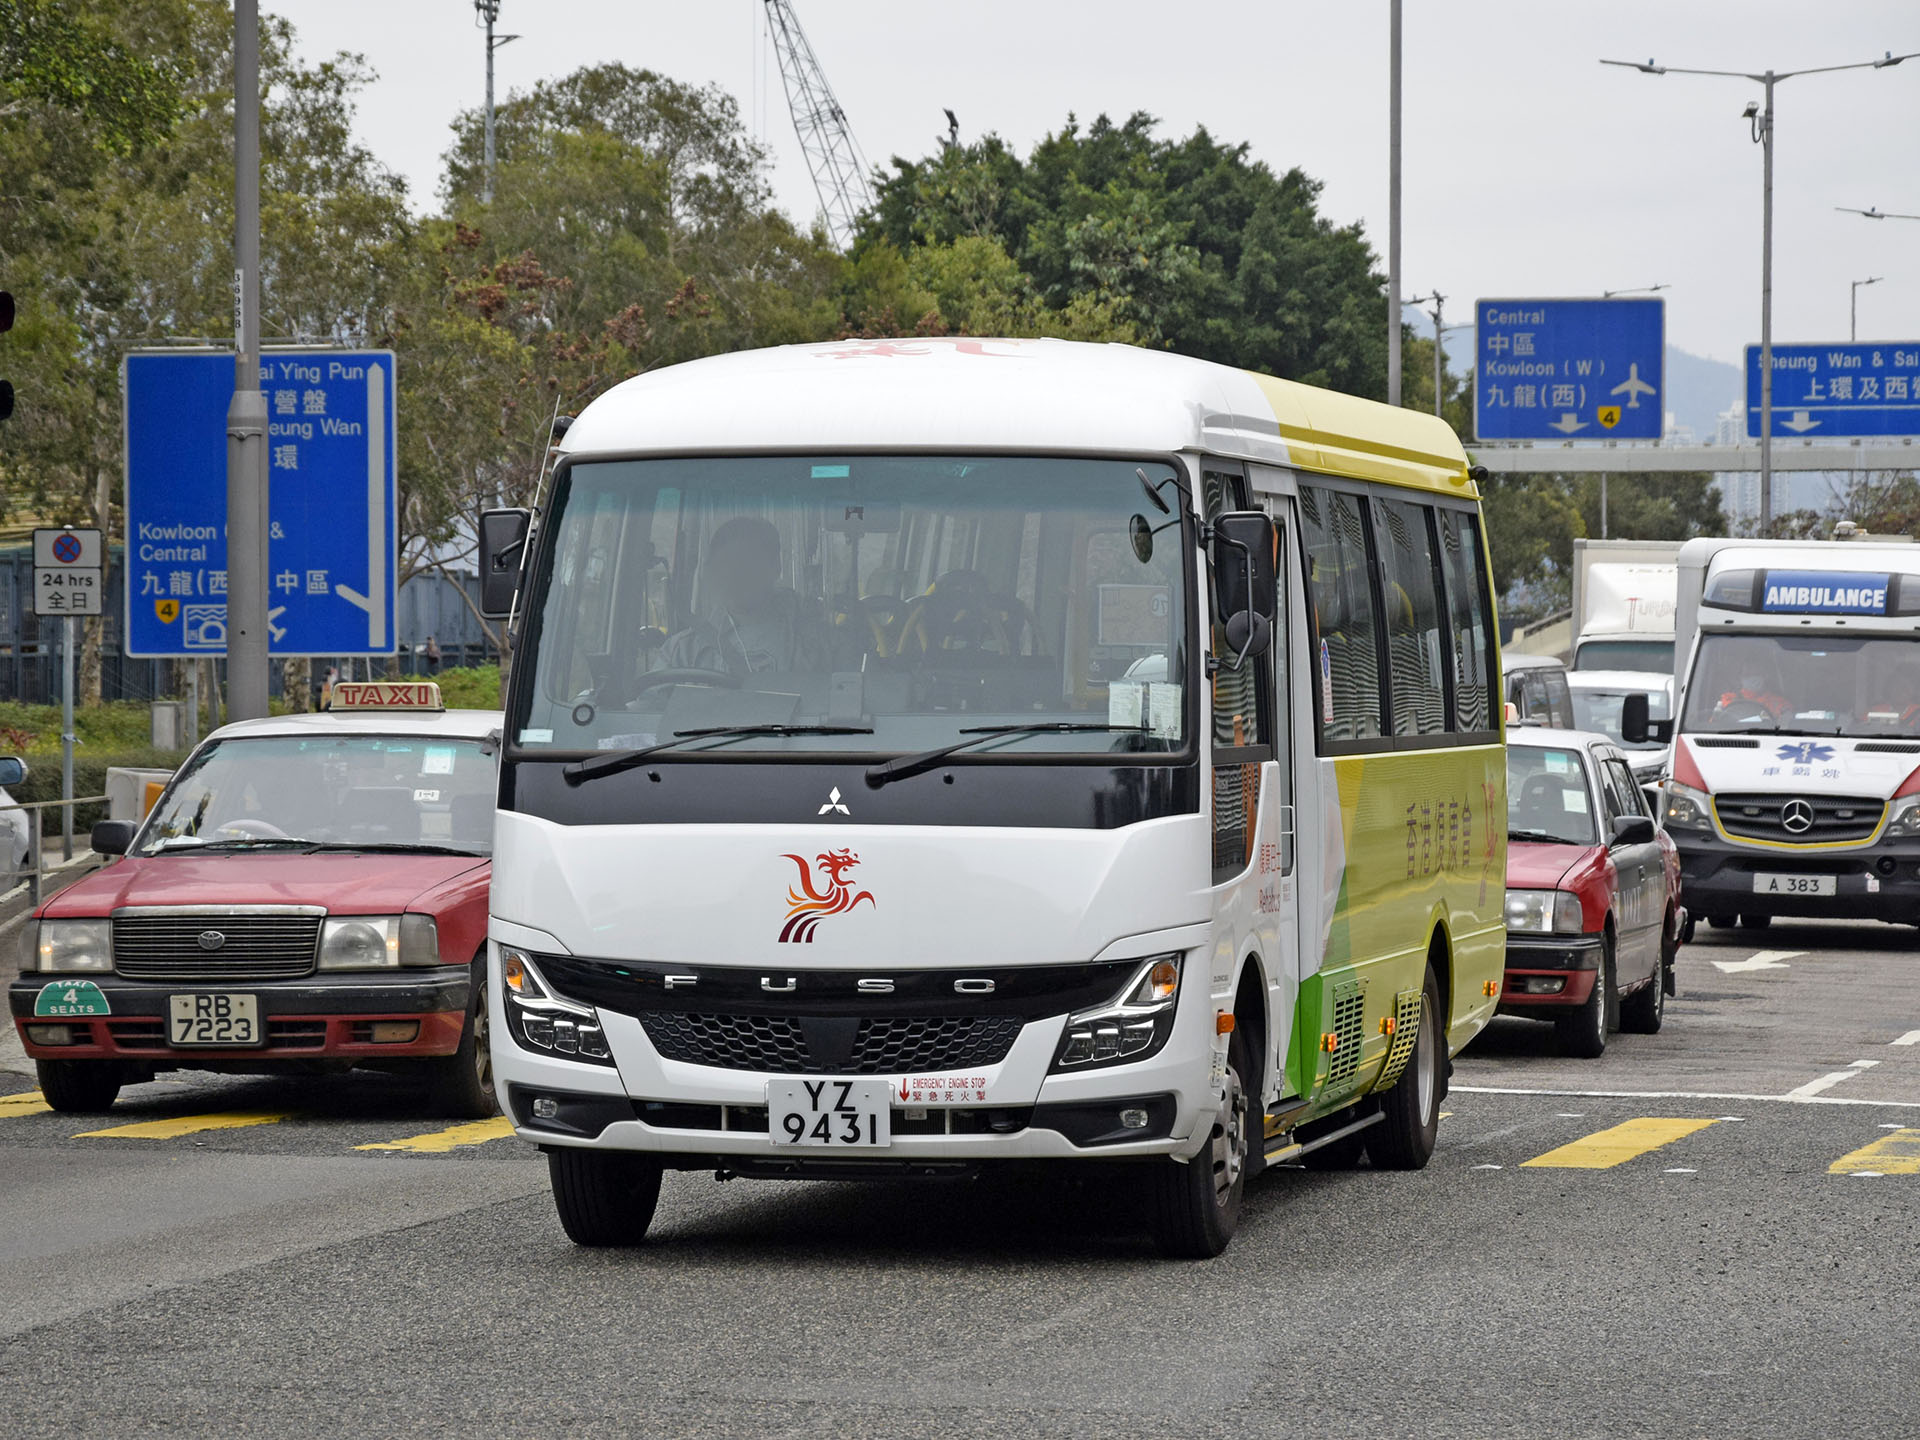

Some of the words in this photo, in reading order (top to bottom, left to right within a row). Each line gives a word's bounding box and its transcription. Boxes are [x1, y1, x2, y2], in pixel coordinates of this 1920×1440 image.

[1486, 309, 1545, 325] Central
[1488, 332, 1536, 356] 中區
[1486, 360, 1555, 376] Kowloon
[1828, 352, 1862, 368] Wan
[1872, 351, 1884, 367] &
[1894, 350, 1919, 367] Sai
[279, 362, 321, 383] Ying
[328, 362, 364, 380] Pun
[1487, 384, 1586, 408] 九龍(西)
[1603, 411, 1616, 424] 4
[268, 421, 313, 440] eung
[320, 418, 361, 436] Wan
[139, 523, 217, 541] Kowloon
[270, 522, 285, 540] &
[139, 544, 207, 562] Central
[43, 573, 64, 586] 24
[68, 573, 93, 587] hrs
[47, 591, 87, 609] 全日
[1766, 586, 1885, 609] AMBULANCE
[161, 603, 173, 617] 4
[340, 685, 428, 705] TAXI
[1769, 878, 1779, 891] A
[1787, 879, 1820, 892] 383
[664, 975, 995, 993] FUSO
[63, 988, 78, 1004] 4
[50, 1005, 95, 1014] SEATS
[195, 995, 232, 1018] RB
[177, 1018, 251, 1042] 7223
[913, 1077, 946, 1089] EMERGENCY
[948, 1077, 969, 1089] ENGINE
[971, 1077, 986, 1089] STOP
[803, 1081, 856, 1112] YZ
[783, 1112, 876, 1144] 9431
